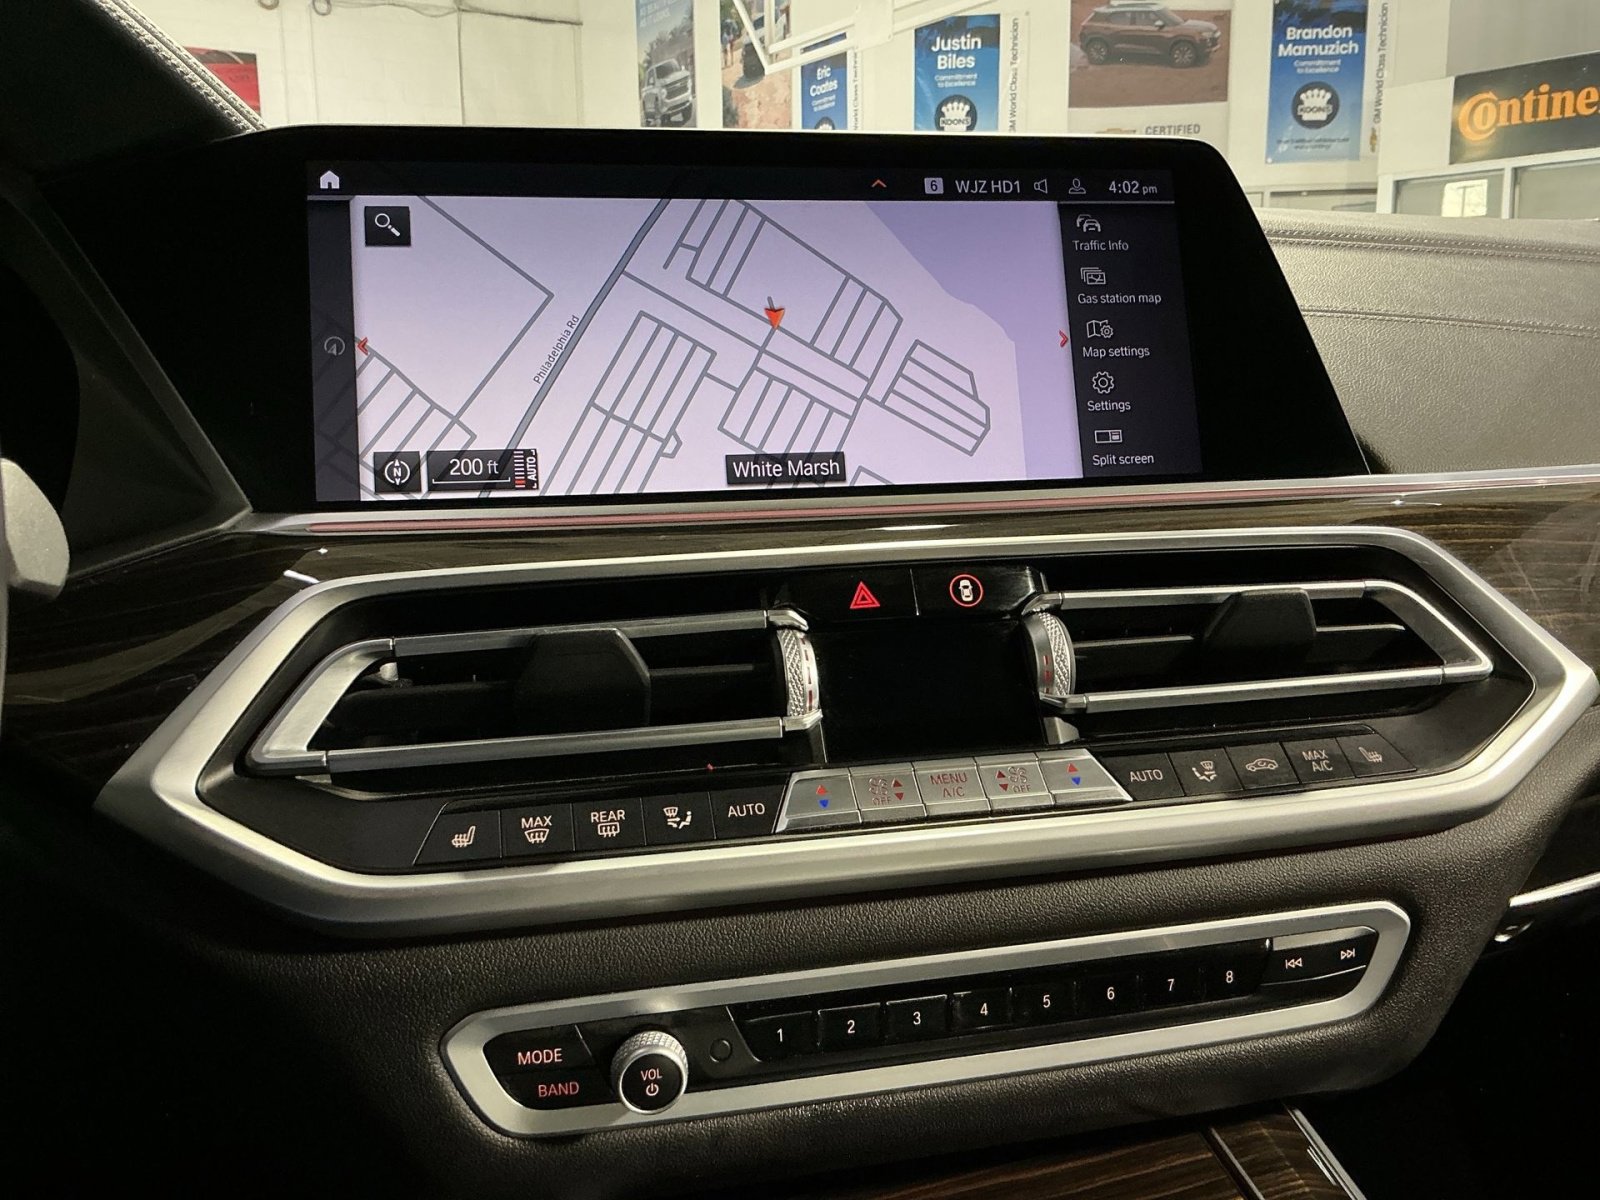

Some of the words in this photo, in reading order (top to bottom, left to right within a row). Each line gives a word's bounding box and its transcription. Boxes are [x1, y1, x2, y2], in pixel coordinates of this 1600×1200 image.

[1286, 24, 1353, 41] Brandon
[1378, 2, 1388, 52] Technician
[931, 34, 981, 52] Justin
[1010, 18, 1019, 66] Technician
[1277, 40, 1359, 58] Mamuzich
[937, 54, 975, 70] Biles
[1376, 54, 1386, 79] Class
[816, 65, 831, 80] Eric
[1010, 68, 1018, 91] Class
[810, 80, 838, 97] Coates
[1375, 80, 1384, 107] World
[1009, 93, 1017, 119] World
[1299, 105, 1332, 114] KOONS
[1458, 84, 1600, 141] Contine
[940, 118, 970, 126] KOONS
[1145, 124, 1201, 135] CERTIFIED
[929, 180, 938, 191] 6
[955, 180, 987, 194] WJZ
[991, 180, 1021, 194] HD1
[1108, 180, 1140, 194] 4:02
[1142, 184, 1158, 196] pm
[1072, 239, 1106, 251] Traffic
[1108, 239, 1129, 251] Info
[1077, 293, 1098, 305] Gas
[1100, 293, 1136, 304] station
[1138, 294, 1162, 305] map
[533, 329, 572, 385] Philadelphia
[567, 314, 580, 329] Rd
[1082, 346, 1106, 358] Map
[1108, 346, 1150, 359] settings
[1087, 400, 1131, 412] Settings
[450, 458, 483, 476] 200
[487, 459, 499, 475] ft
[1092, 454, 1117, 467] Split
[1119, 455, 1154, 465] screen
[393, 467, 402, 477] N
[527, 457, 537, 482] AUTO
[733, 461, 783, 478] White
[788, 459, 840, 477] Marsh
[1302, 749, 1329, 761] MAX
[1312, 760, 1334, 772] A/C
[930, 771, 968, 786] MENU
[1129, 769, 1163, 783] AUTO
[942, 785, 965, 798] A/C
[1013, 784, 1031, 793] OFF
[872, 797, 892, 806] OFF
[591, 809, 626, 824] REAR
[728, 802, 766, 818] AUTO
[521, 814, 553, 829] MAX
[1225, 971, 1234, 984] 8
[1167, 979, 1175, 992] 7
[1107, 987, 1115, 1000] 6
[1042, 995, 1051, 1008] 5
[980, 1002, 989, 1016] 4
[913, 1012, 921, 1025] 3
[847, 1020, 855, 1034] 2
[777, 1028, 783, 1042] 1
[517, 1048, 563, 1065] MODE
[640, 1068, 663, 1081] VOL
[538, 1081, 580, 1098] BAND
